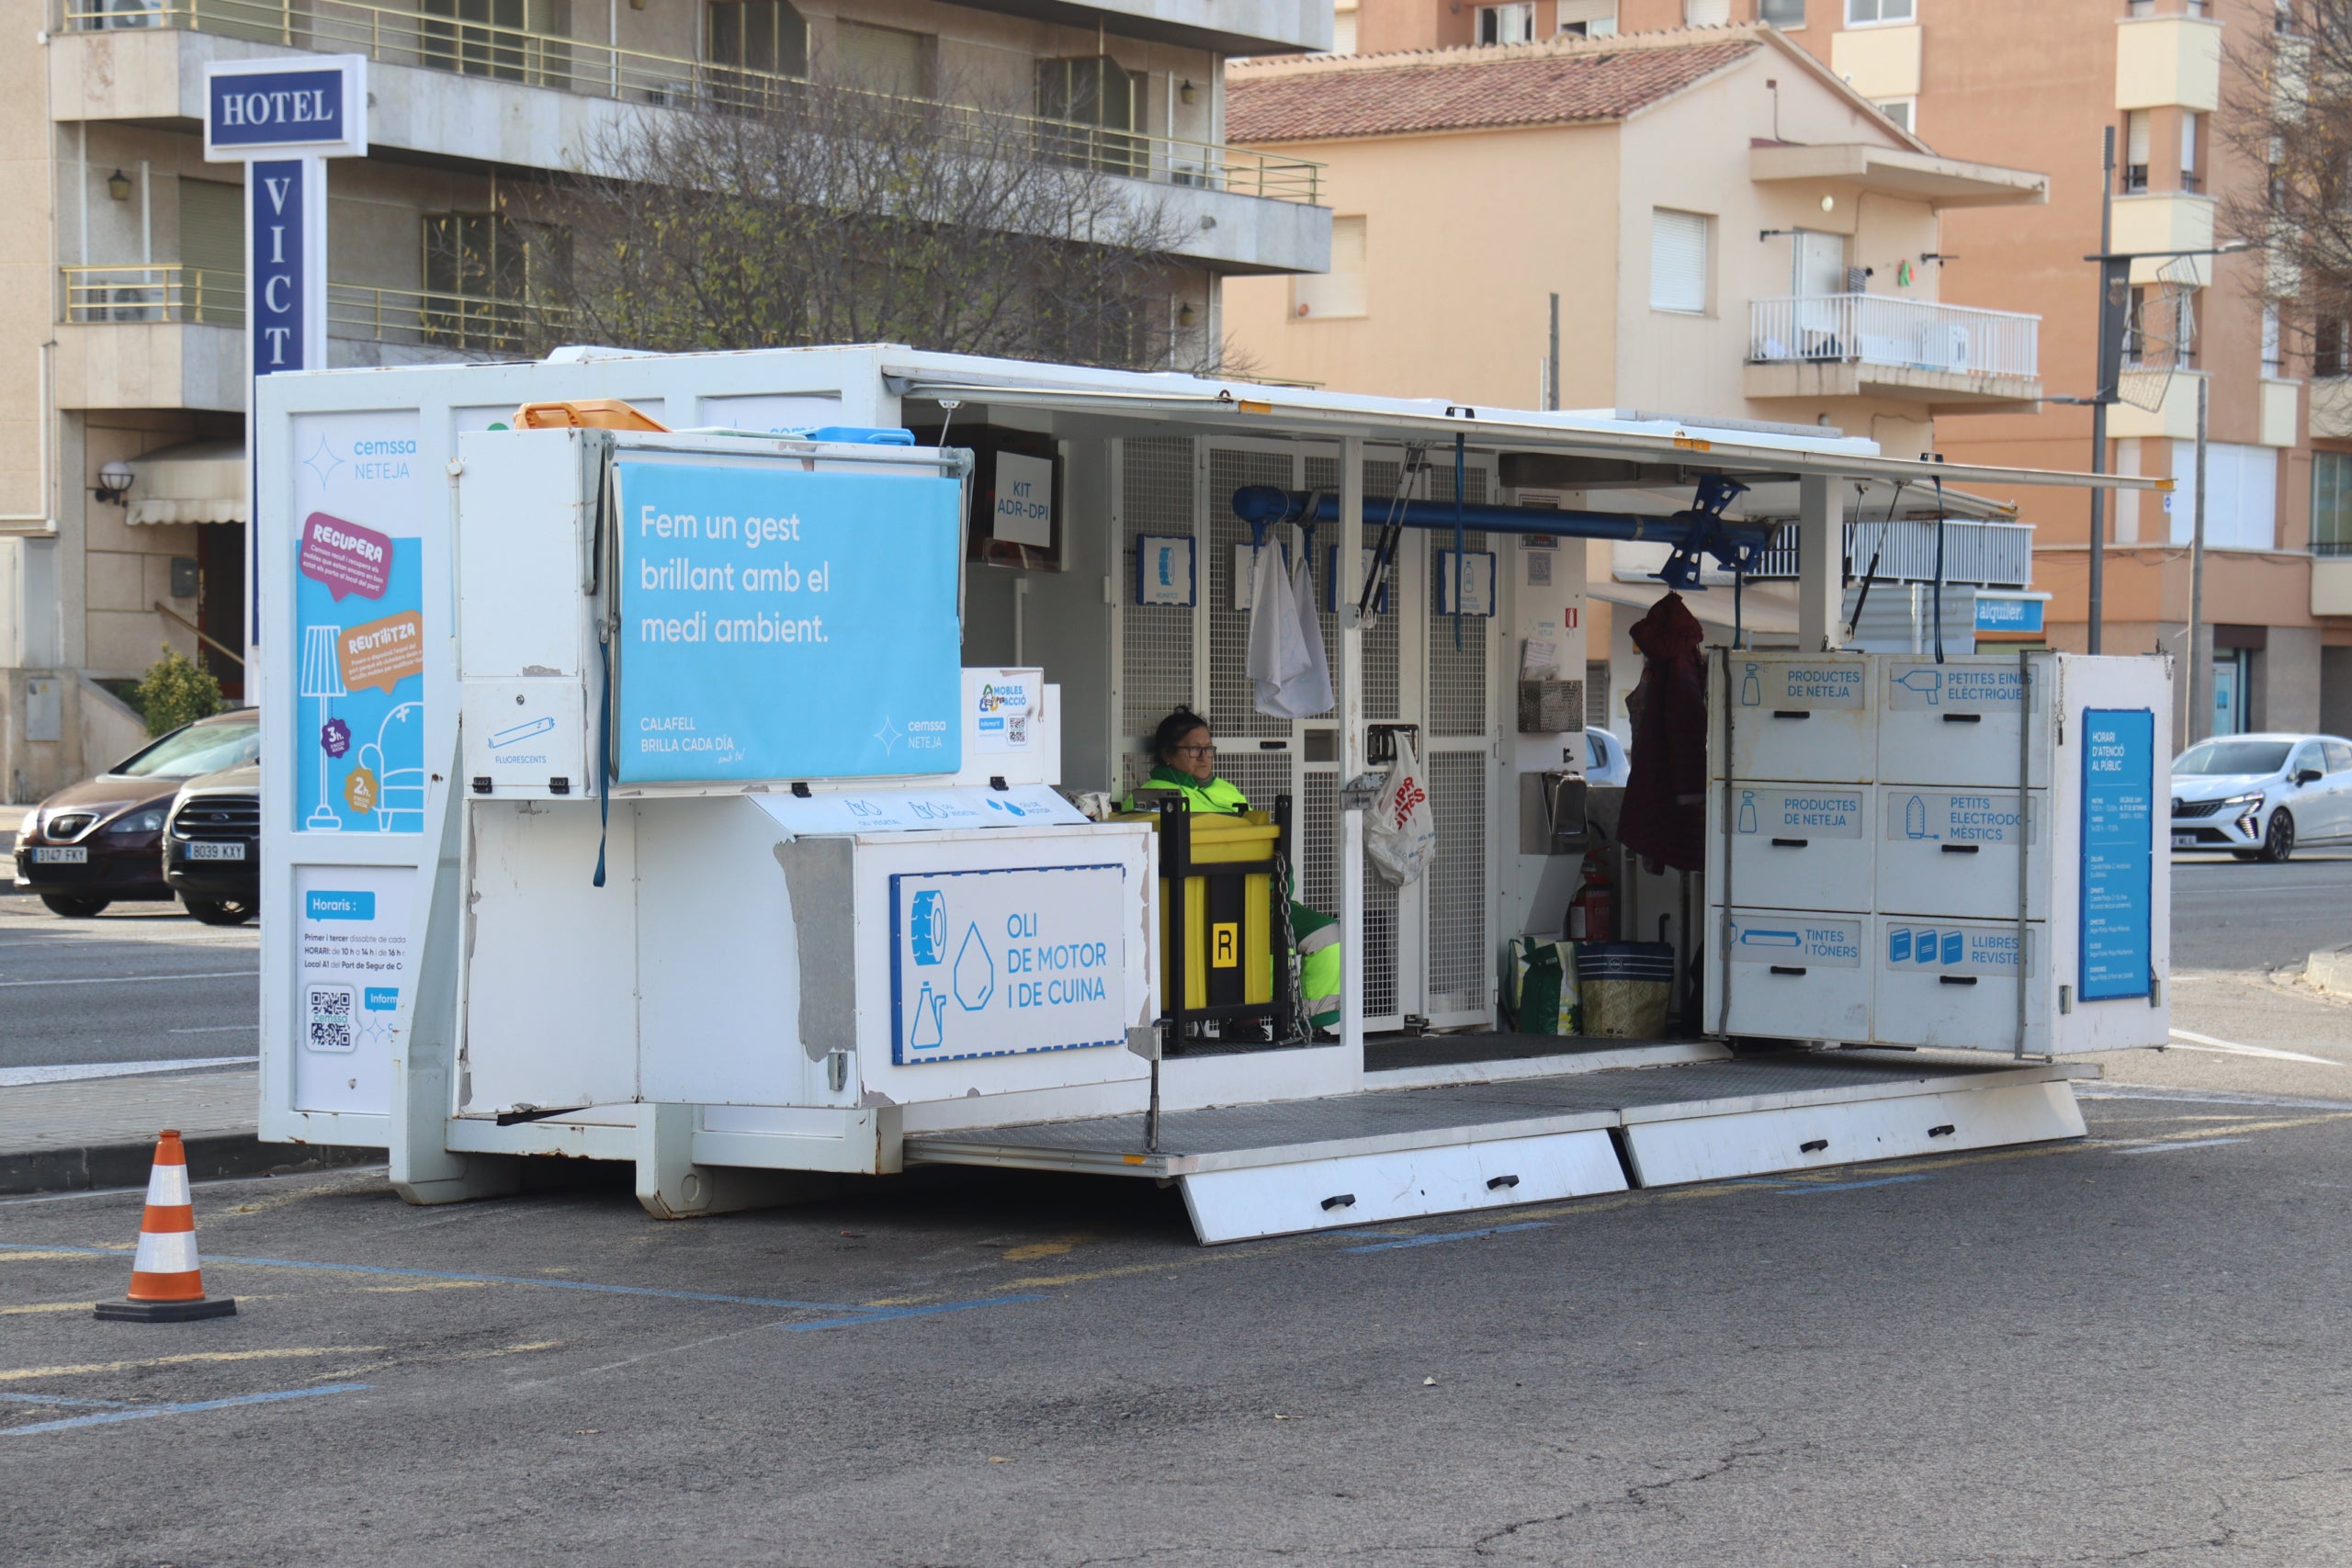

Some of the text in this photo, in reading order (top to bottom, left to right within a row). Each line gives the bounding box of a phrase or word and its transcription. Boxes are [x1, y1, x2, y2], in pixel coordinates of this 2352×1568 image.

[221, 89, 334, 126] HOTEL
[264, 177, 291, 365] VICT
[354, 439, 416, 456] cemssa
[355, 462, 410, 479] NETEJA
[1013, 481, 1032, 498] KIT
[997, 498, 1048, 522] ADR-DPI
[640, 505, 800, 549] Fem un gest
[313, 524, 383, 563] RECUPERA
[640, 558, 830, 592] brillant amb el
[1979, 601, 2023, 624] alquiler.
[641, 612, 829, 643] medi ambient.
[1787, 671, 1860, 683] PRODUCTES
[1949, 672, 1996, 684] PETITES
[993, 685, 1023, 695] MOBLES
[1787, 685, 1850, 698] DE NETEJA
[1949, 685, 2023, 700] ELÈCTRIQUE
[1004, 694, 1026, 706] ACCIÓ
[640, 716, 696, 731] CALAFELL
[908, 719, 946, 732] cemssa
[640, 733, 734, 752] BRILLA CADA DÍA
[908, 736, 943, 750] NETEJA
[2092, 730, 2116, 743] HORARI
[2091, 743, 2125, 758] D'ATENCIÓ
[495, 755, 548, 764] FLUORESCENTS
[2091, 758, 2122, 772] AL PÚBLIC
[1784, 798, 1857, 812] PRODUCTES
[1951, 796, 1991, 809] PETITS
[1784, 814, 1847, 827] DE NETEJA
[1951, 825, 2003, 840] MÈSTICS
[39, 848, 85, 861] 3147 FKY
[193, 844, 243, 859] 8039 KXY
[312, 898, 351, 911] Horaris
[1007, 912, 1037, 939] OLI
[304, 933, 324, 942] Primer
[330, 934, 348, 942] tercer
[350, 934, 377, 942] dissabte
[378, 935, 387, 943] de
[1805, 929, 1844, 942] TINTES
[1972, 936, 2019, 949] LLIBRES
[1217, 930, 1232, 960] R
[1805, 942, 1858, 958] I TÒNERS
[361, 948, 368, 956] 14
[369, 948, 374, 956] h
[389, 949, 396, 957] 16
[397, 949, 401, 957] h
[1008, 942, 1107, 974] DE MOTOR
[1972, 951, 2022, 964] REVISTE
[304, 960, 321, 968] Local
[342, 961, 355, 969] Port
[356, 962, 365, 970] de
[366, 962, 385, 972] Segur
[386, 962, 395, 970] de
[1008, 976, 1106, 1009] I DE CUINA
[313, 1014, 348, 1023] cemssa
